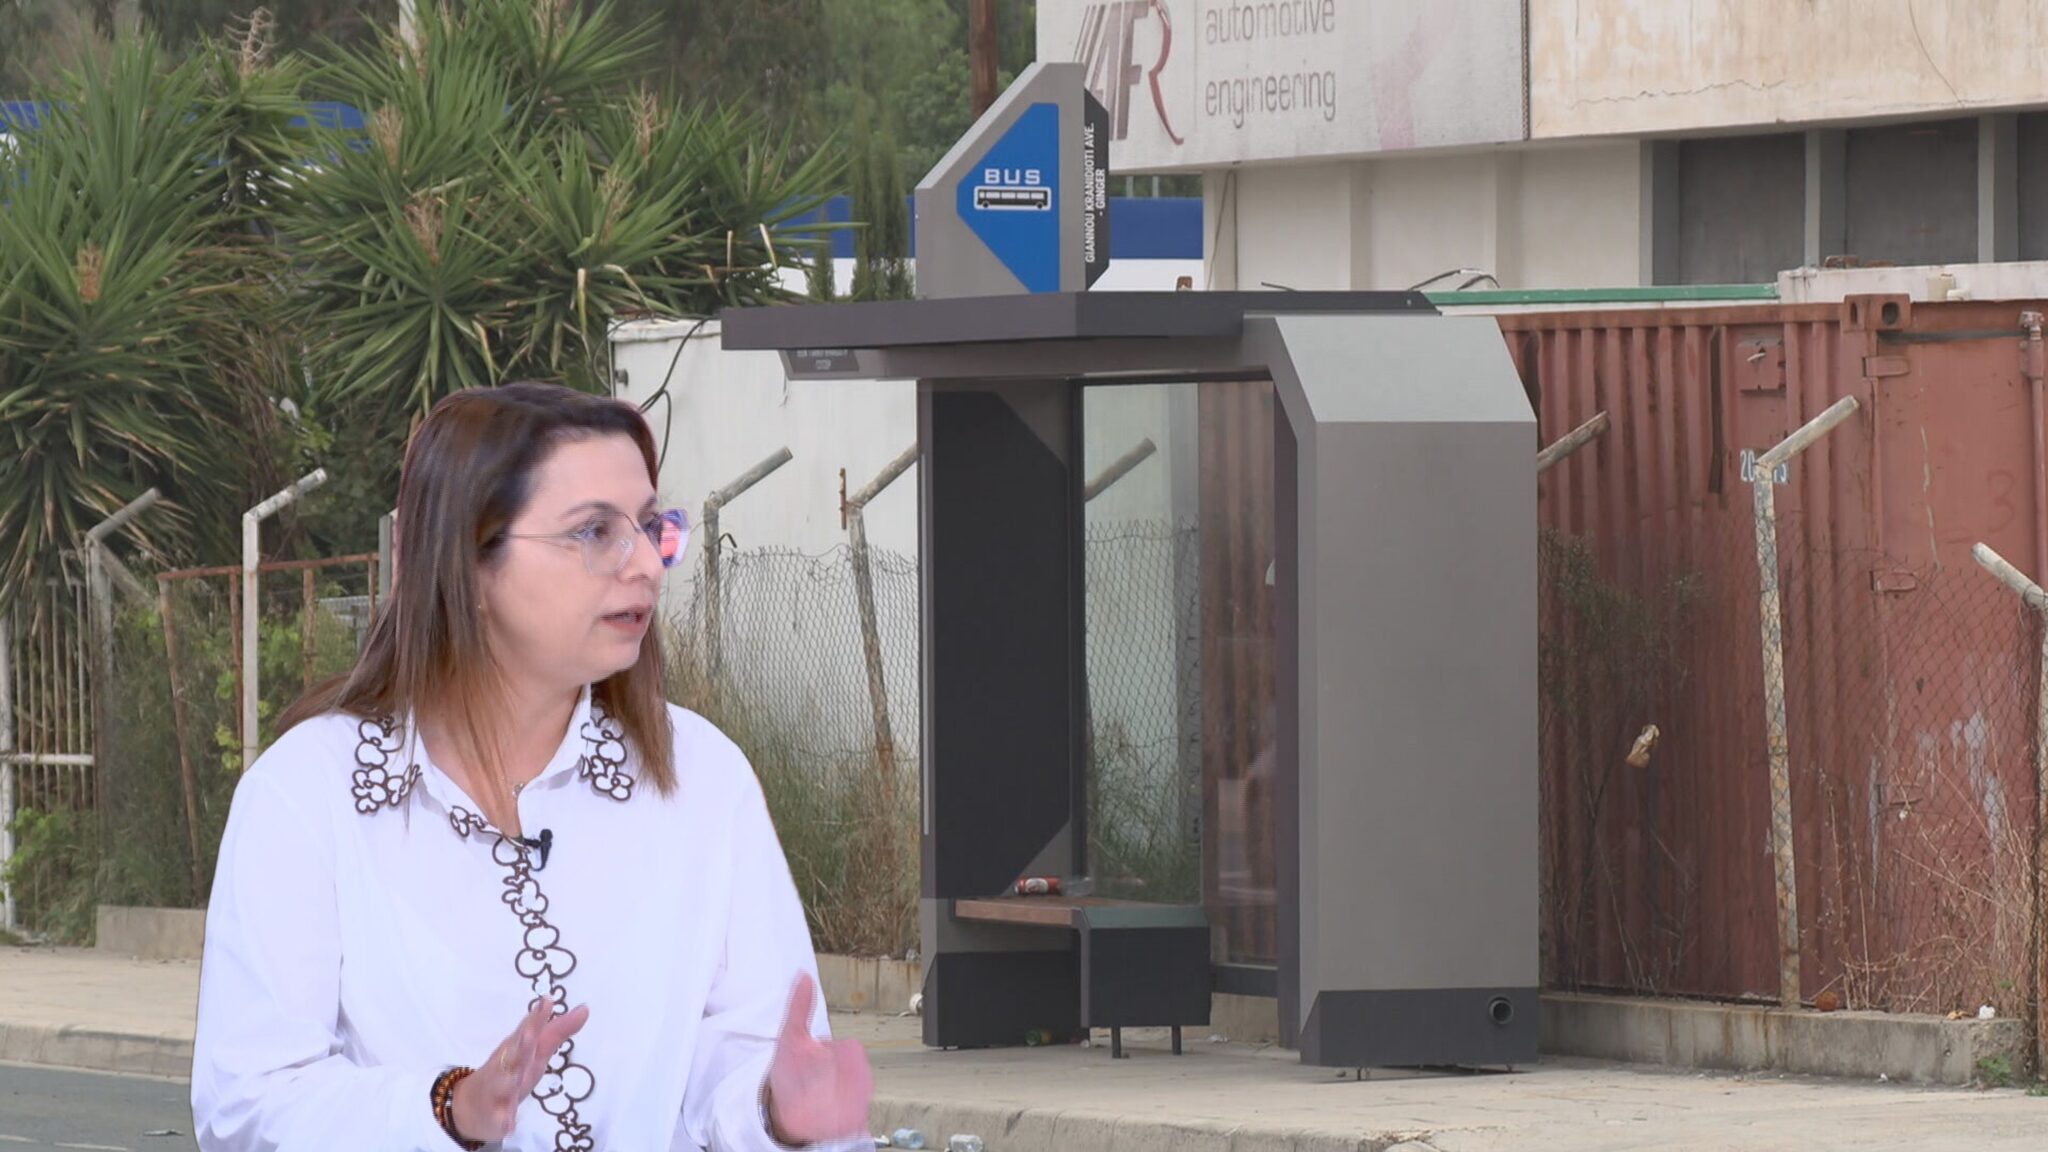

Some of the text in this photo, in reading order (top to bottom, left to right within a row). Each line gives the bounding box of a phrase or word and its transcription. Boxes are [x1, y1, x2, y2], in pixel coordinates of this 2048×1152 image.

[1206, 0, 1336, 45] automotive
[1205, 58, 1337, 130] engineering
[984, 168, 1041, 185] BUS
[1084, 149, 1095, 213] KRANIDIOTI
[1095, 168, 1106, 209] GINGER
[1084, 214, 1096, 263] GIANNOU
